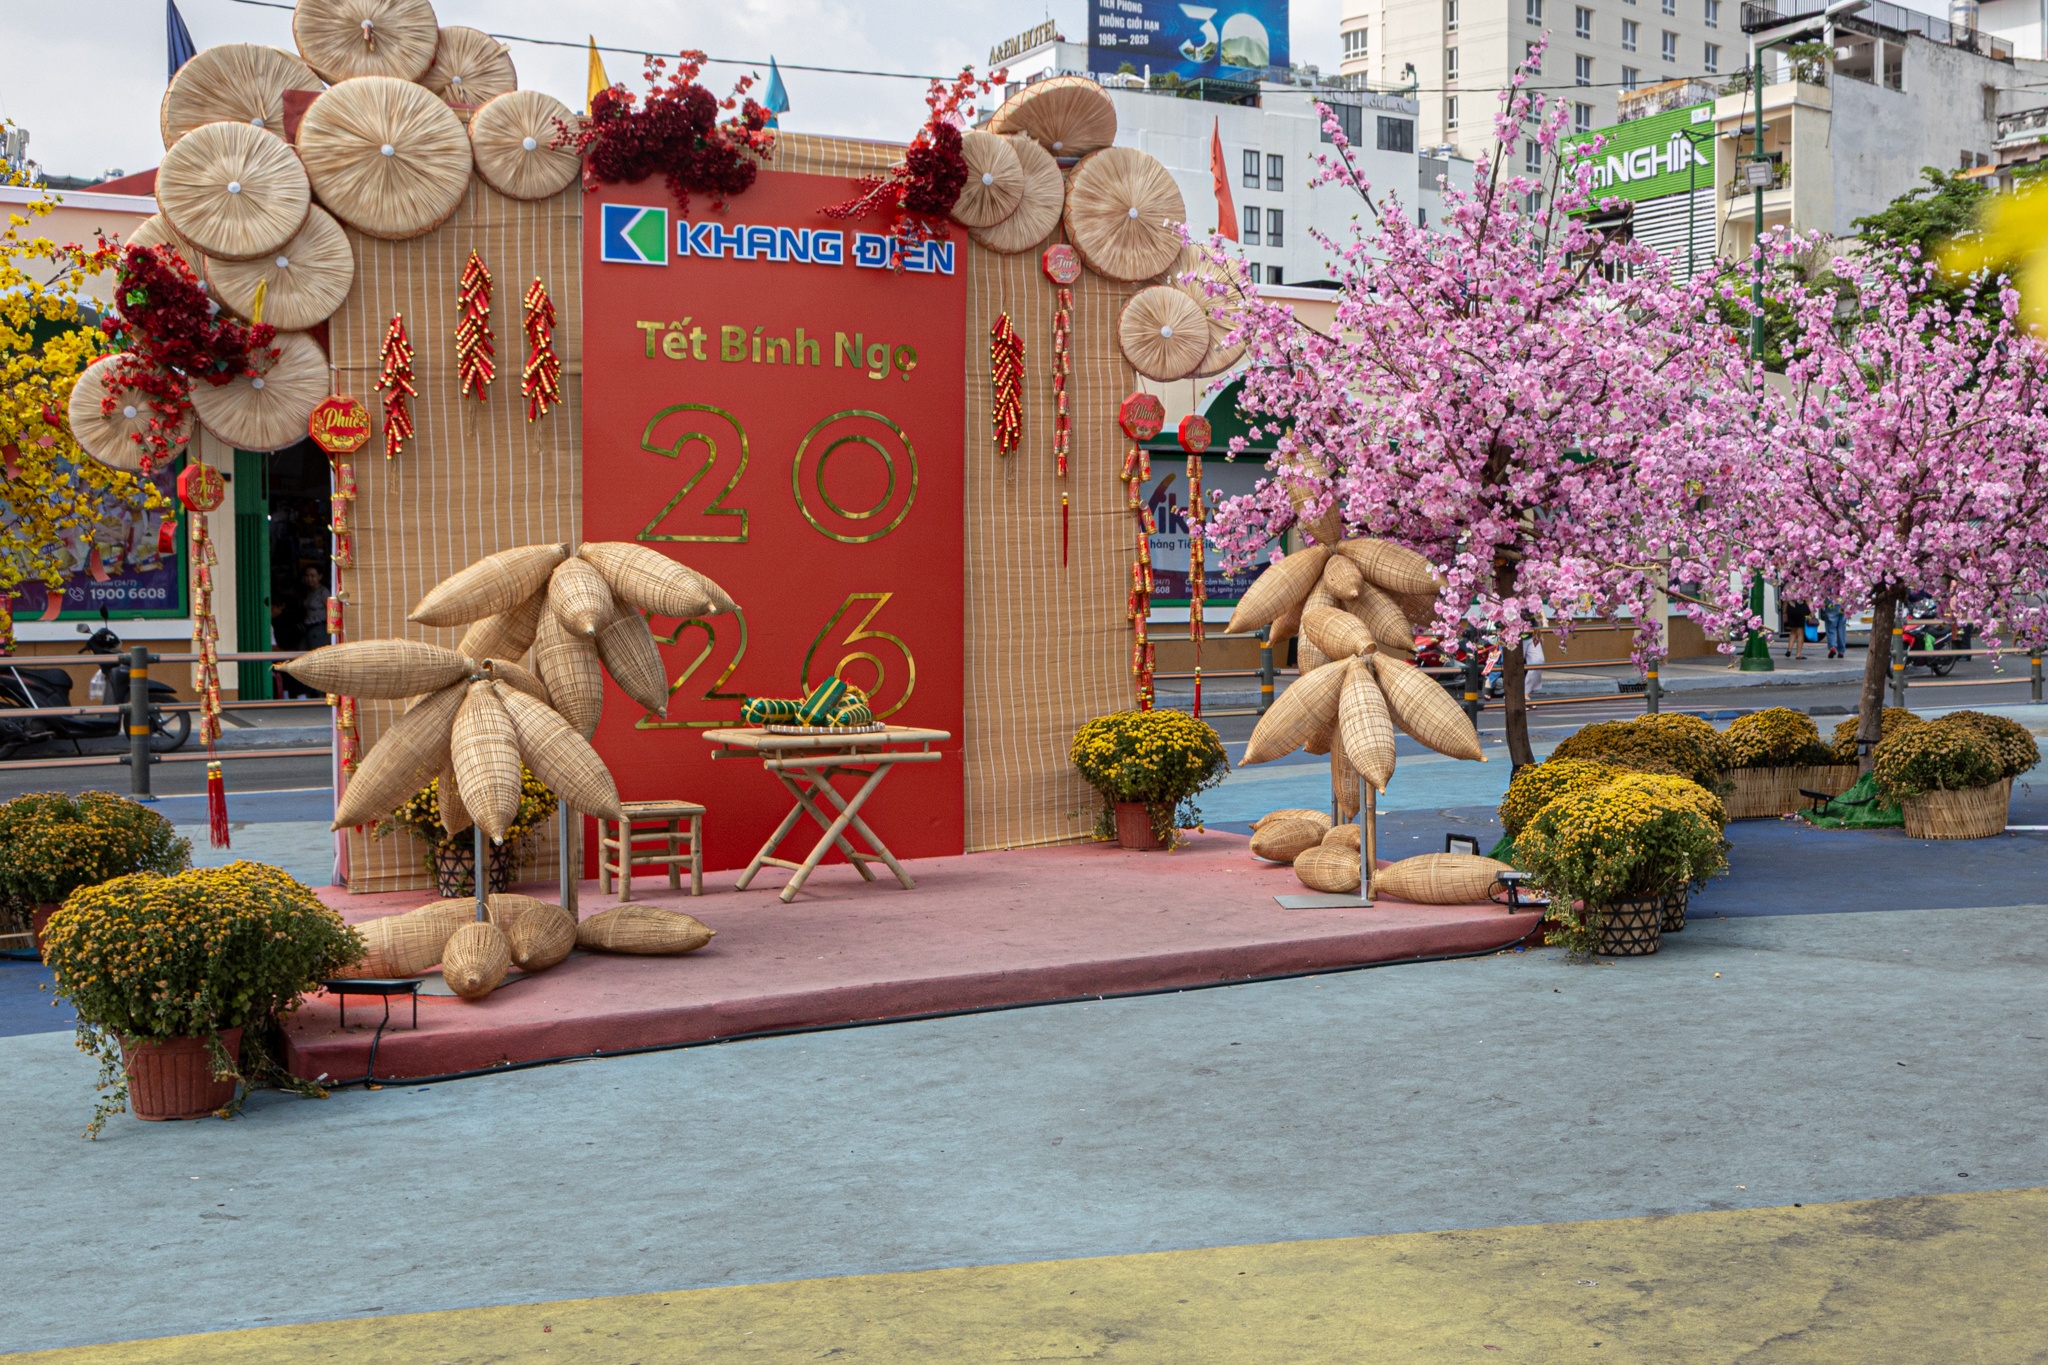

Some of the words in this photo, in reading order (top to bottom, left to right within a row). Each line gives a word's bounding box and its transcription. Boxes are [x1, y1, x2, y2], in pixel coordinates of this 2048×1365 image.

[1117, 0, 1143, 14] PHONG
[1099, 12, 1125, 29] KHÔNG
[1144, 19, 1160, 32] HẠN
[988, 34, 1020, 67] A&EM
[1020, 18, 1058, 53] HOTEL
[1099, 33, 1117, 46] 1996
[1130, 34, 1149, 45] 2026
[677, 220, 843, 265] KHANG
[636, 316, 708, 361] Tết
[720, 325, 820, 366] Bính
[834, 331, 918, 381] Ngọ
[90, 588, 126, 600] 1900
[128, 588, 167, 600] 6608
